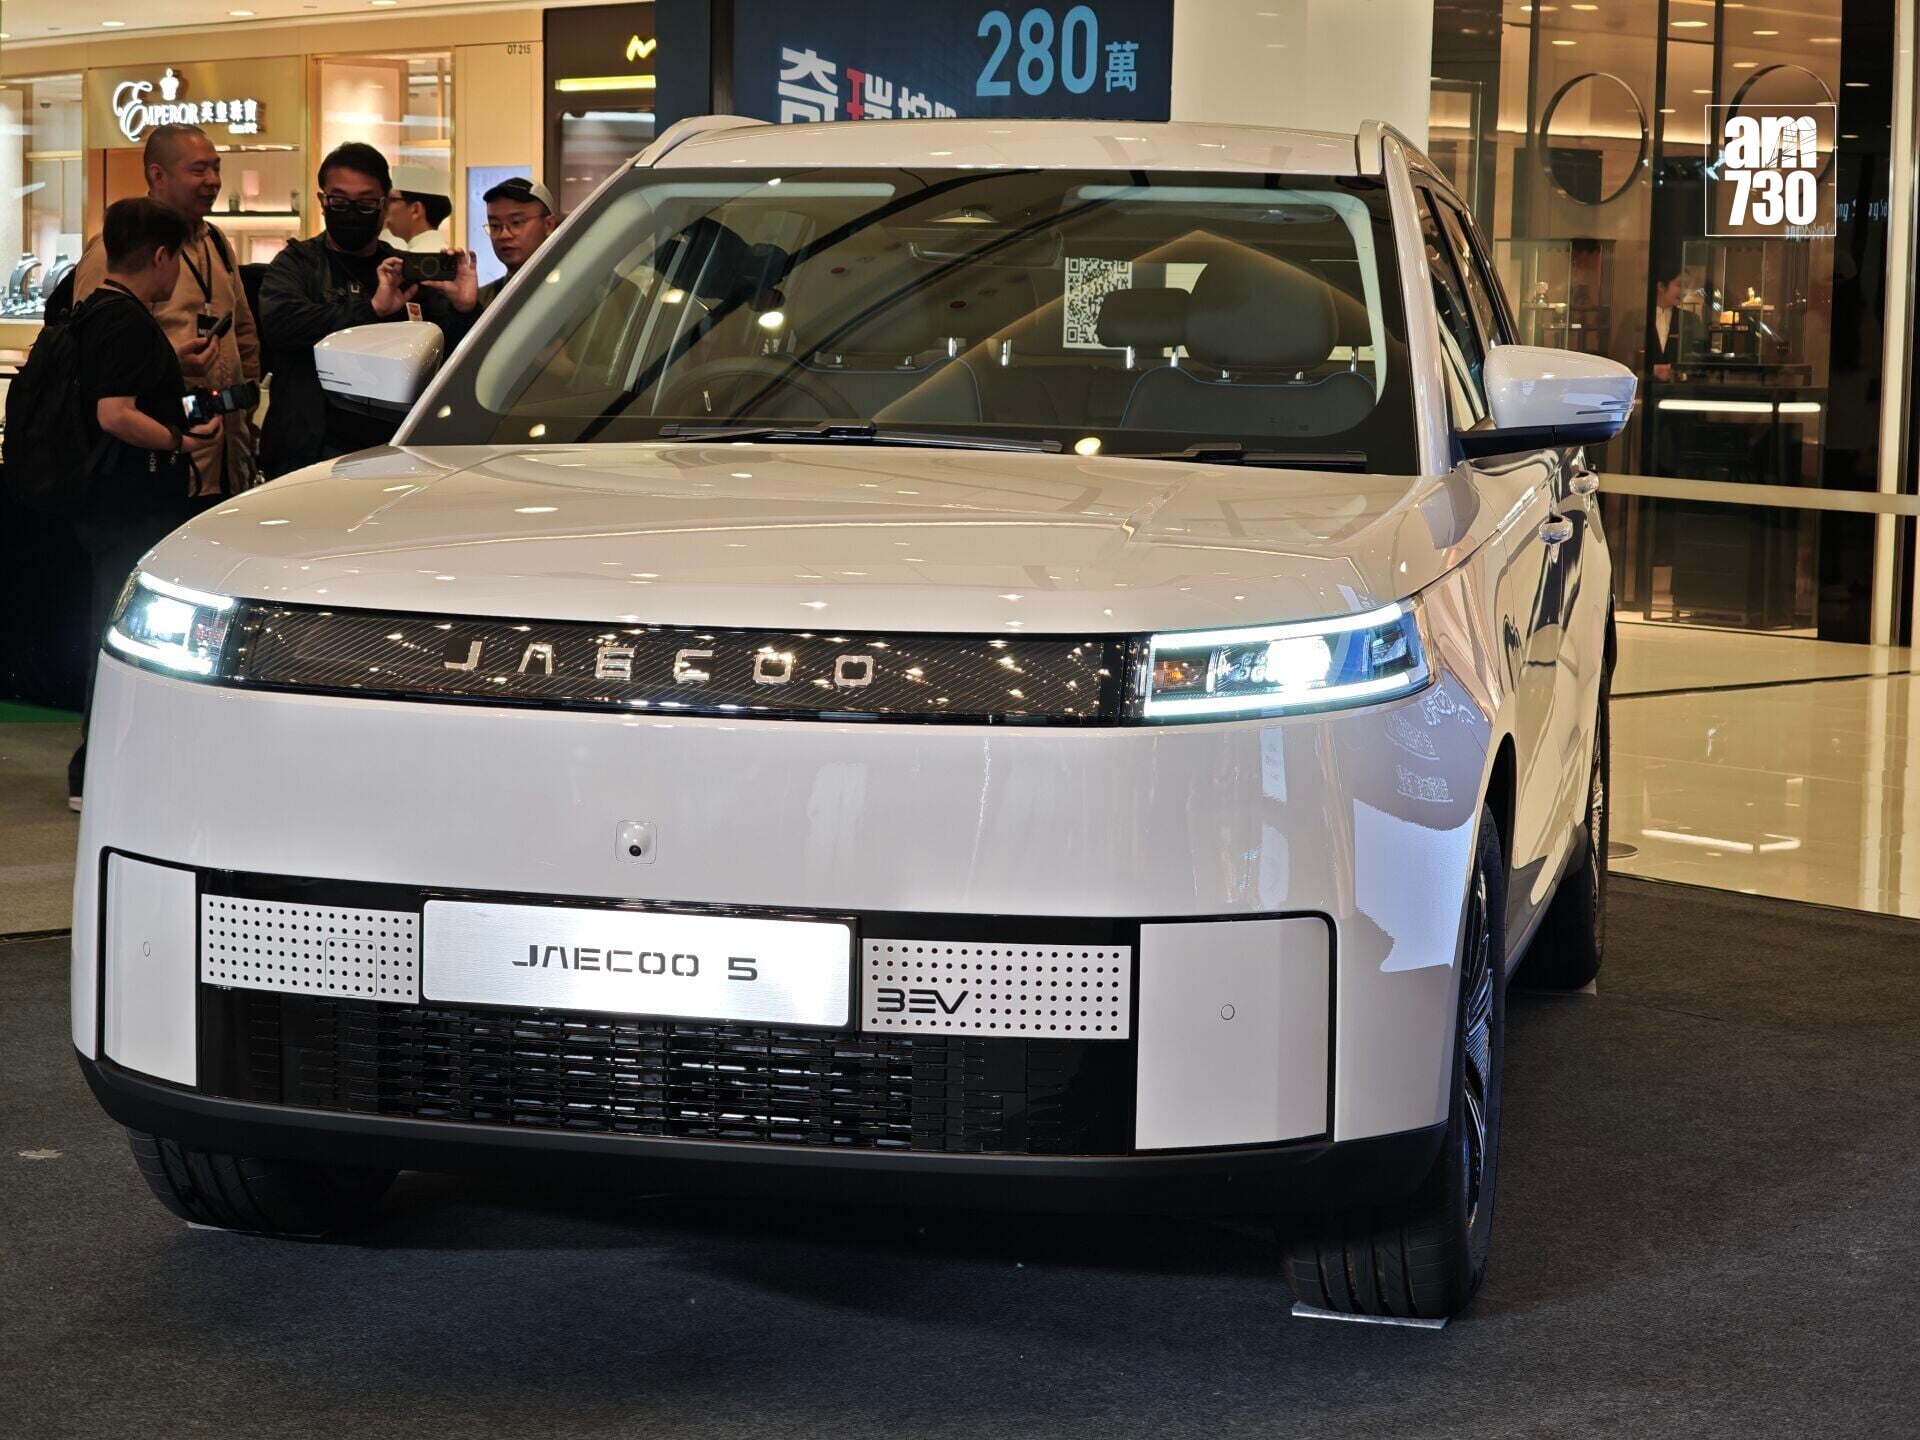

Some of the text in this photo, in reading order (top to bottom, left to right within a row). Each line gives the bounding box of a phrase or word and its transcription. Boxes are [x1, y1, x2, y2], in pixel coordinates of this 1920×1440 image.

[518, 44, 532, 55] 215
[444, 641, 875, 687] JAECOO
[511, 944, 758, 981] JAECOO 5
[876, 988, 969, 1015] BEV
